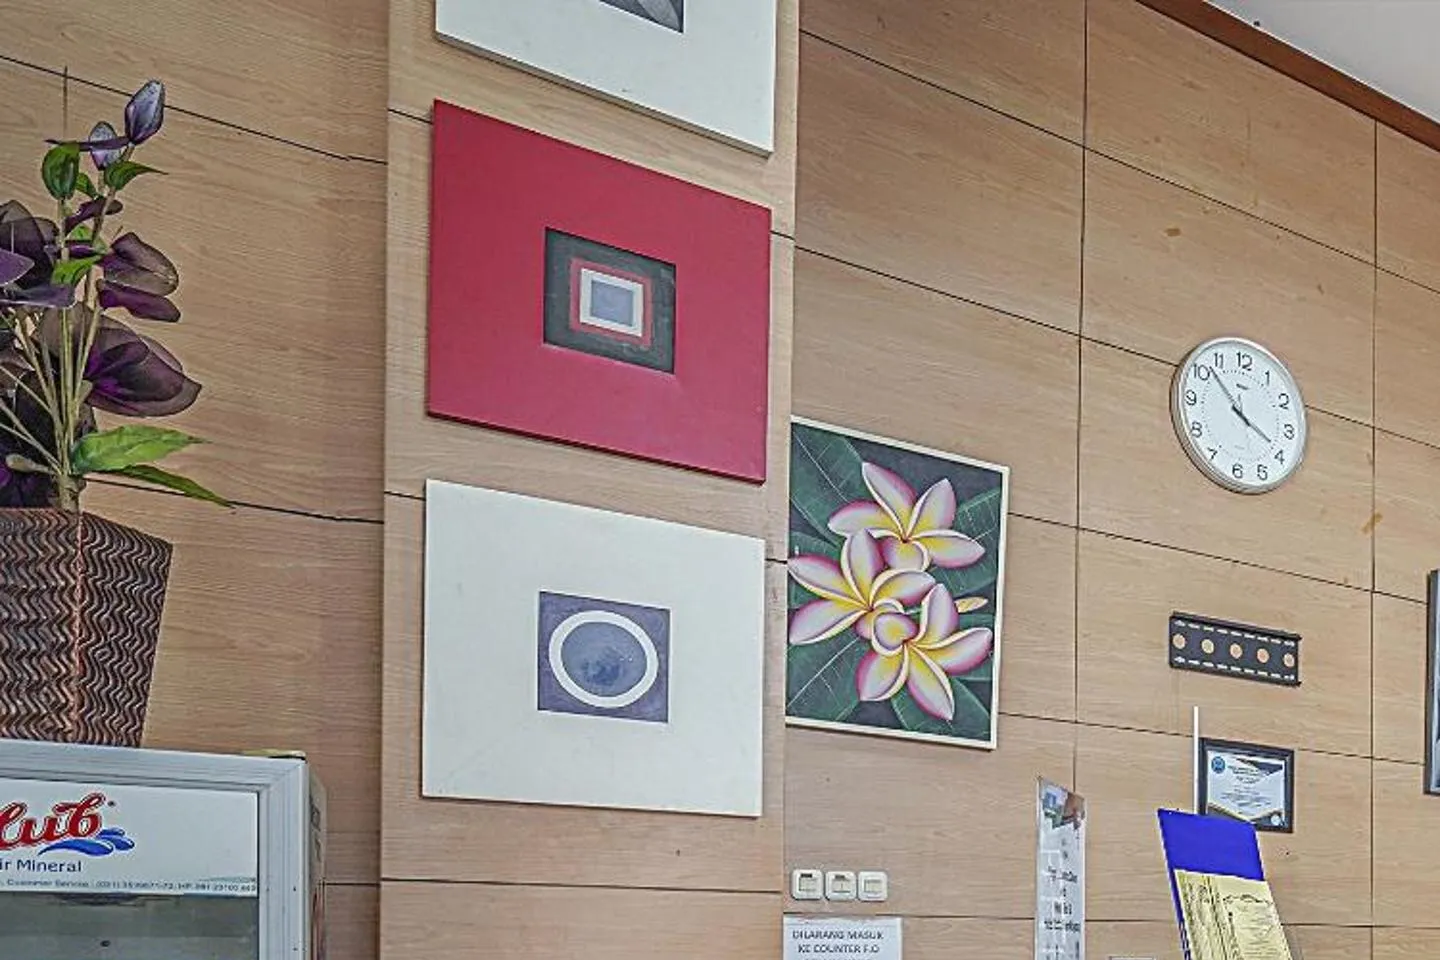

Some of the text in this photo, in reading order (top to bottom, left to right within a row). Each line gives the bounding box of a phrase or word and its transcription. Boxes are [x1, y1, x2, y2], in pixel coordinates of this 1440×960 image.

[1214, 352, 1224, 369] 11
[1236, 352, 1252, 371] 12
[1192, 363, 1210, 381] 10
[1265, 370, 1270, 387] 1
[1185, 389, 1197, 406] 9
[1278, 392, 1289, 410] 2
[1191, 422, 1203, 438] 8
[1283, 424, 1295, 440] 3
[1207, 446, 1218, 460] 7
[1274, 450, 1285, 465] 4
[1232, 464, 1243, 479] 6
[1257, 464, 1268, 480] 5
[0, 792, 106, 851] lub
[0, 858, 82, 873] ir Mineral
[792, 930, 884, 940] DILARANG MASUK
[798, 944, 811, 953] KE
[813, 944, 861, 953] COUNTER
